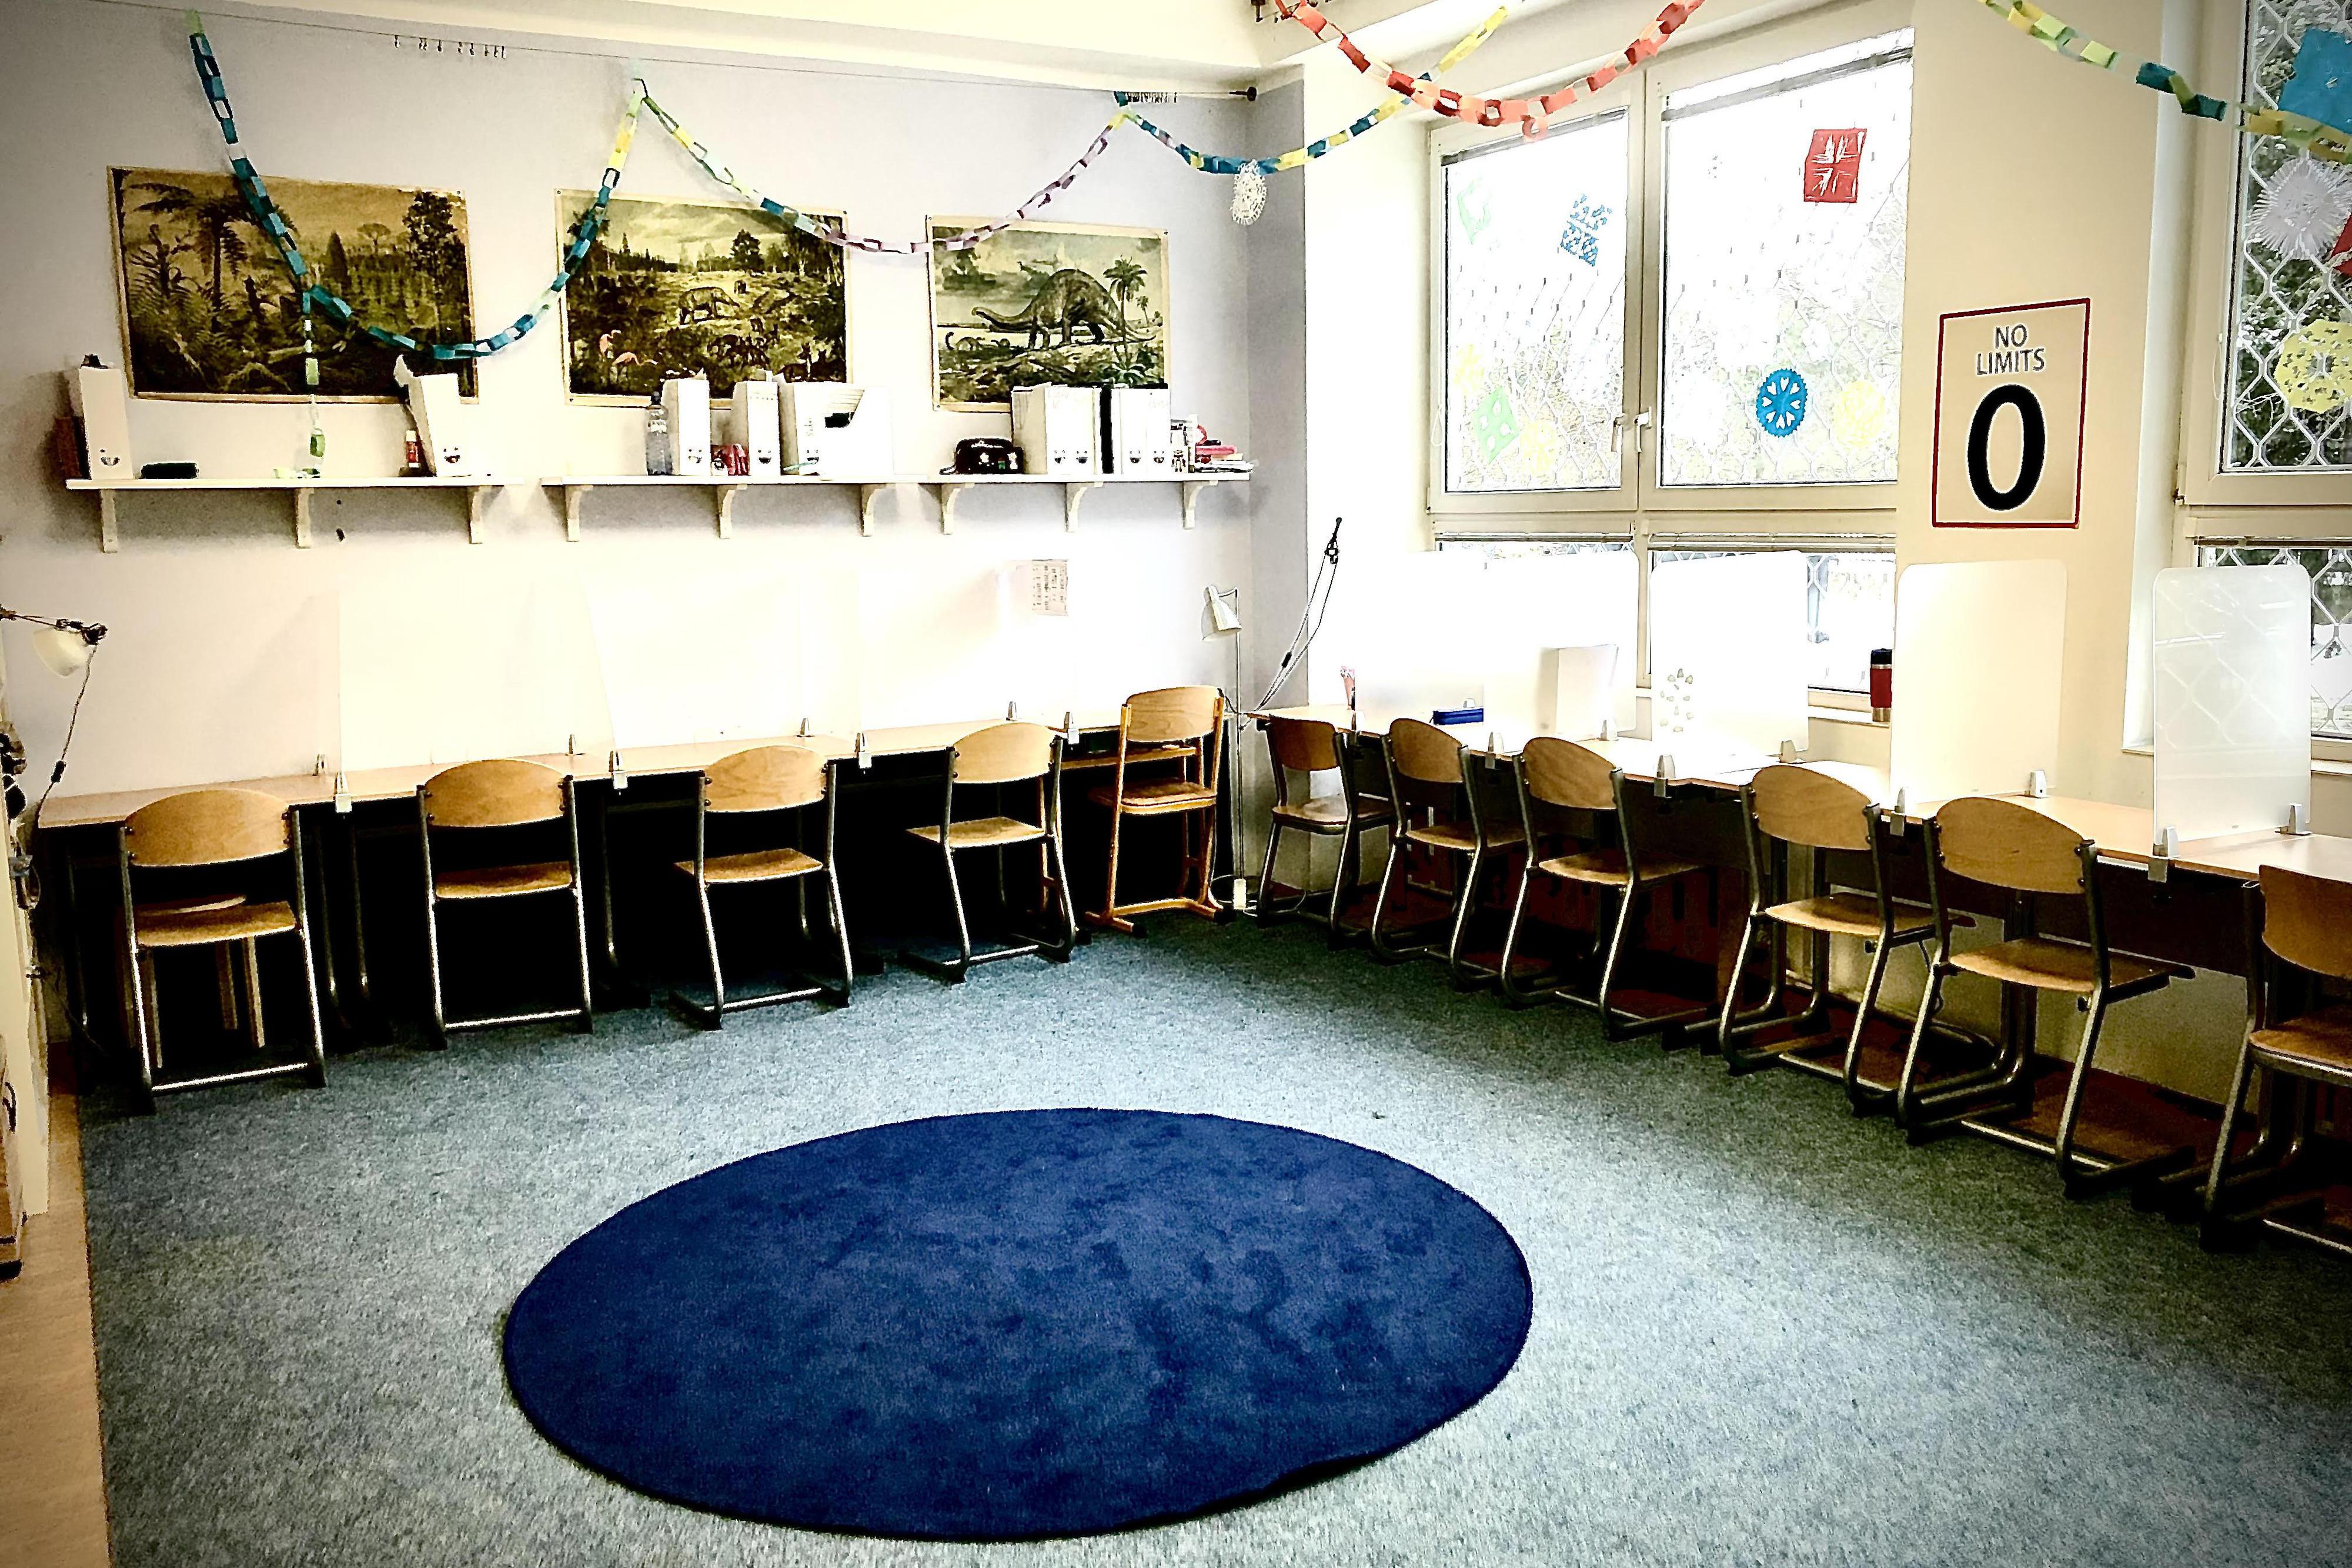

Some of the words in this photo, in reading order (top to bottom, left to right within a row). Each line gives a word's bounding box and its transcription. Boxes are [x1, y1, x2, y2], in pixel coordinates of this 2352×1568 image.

[1995, 325, 2027, 349] NO
[1977, 349, 2044, 375] LIMITS
[1967, 384, 2045, 511] 0
